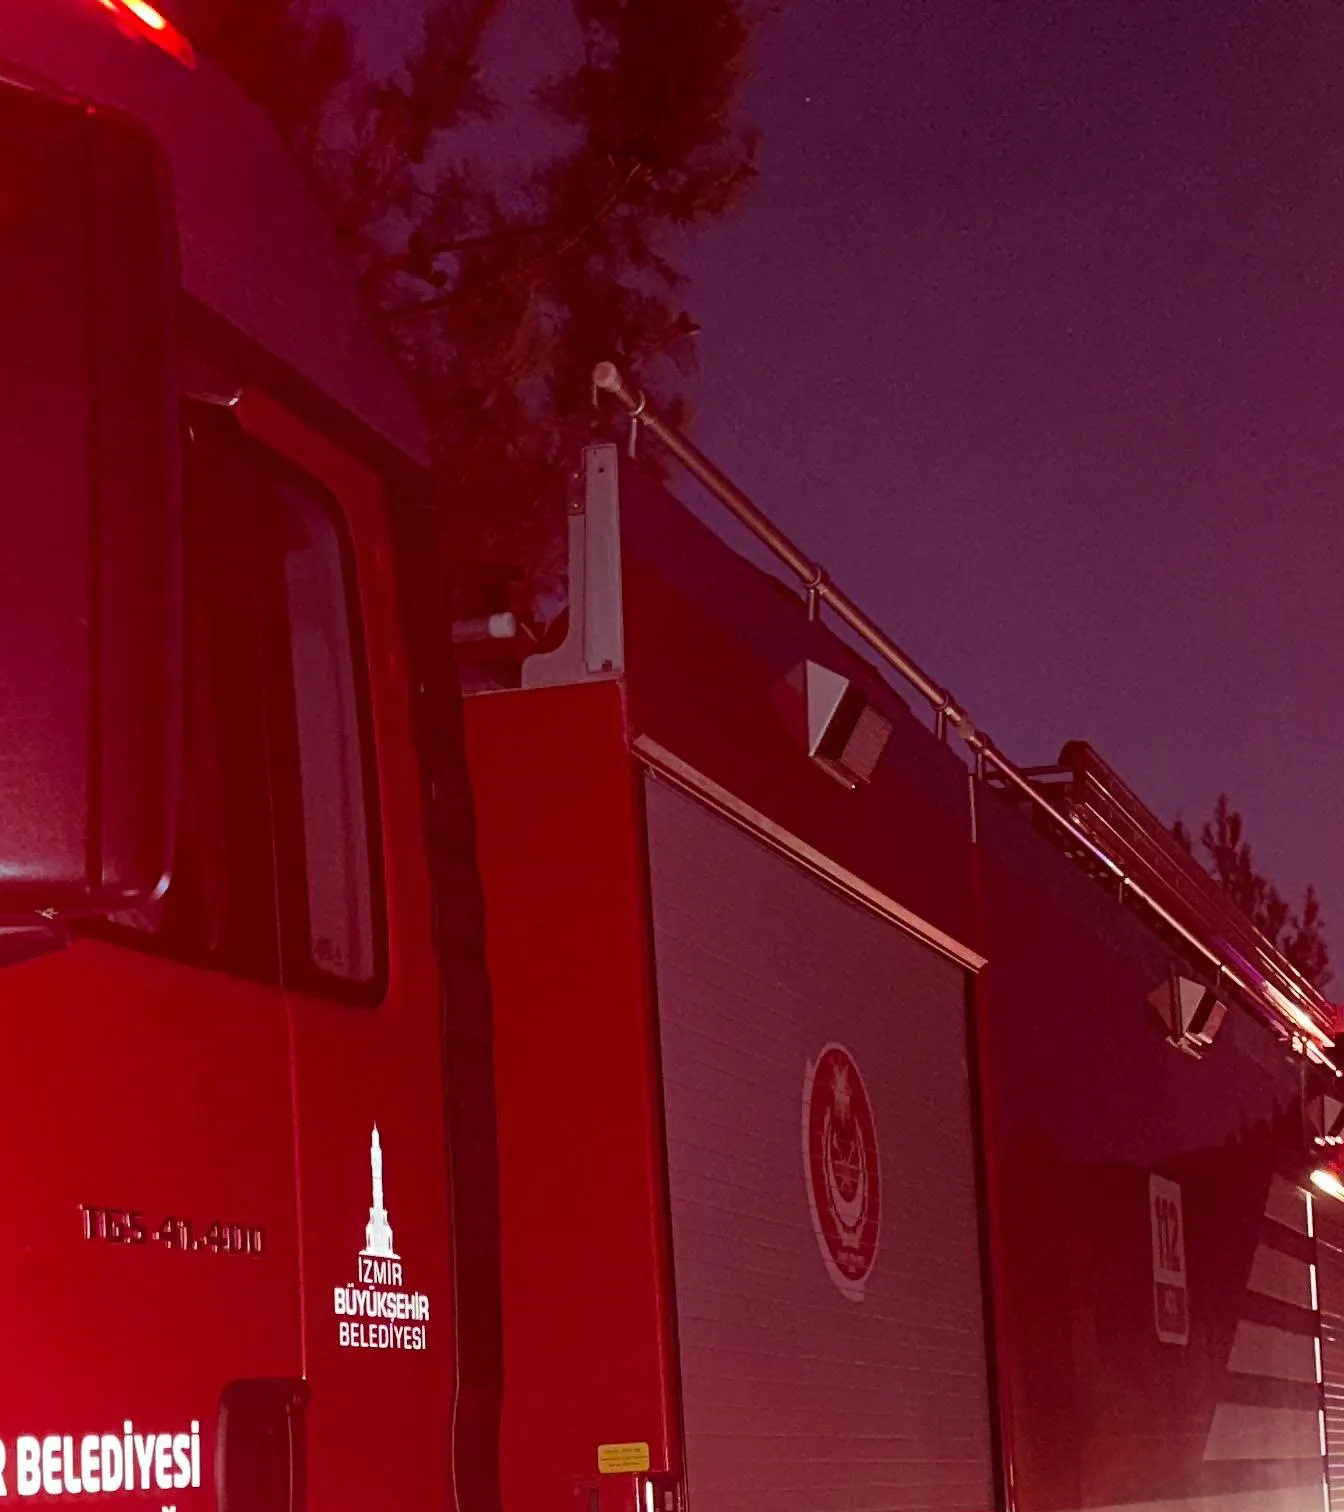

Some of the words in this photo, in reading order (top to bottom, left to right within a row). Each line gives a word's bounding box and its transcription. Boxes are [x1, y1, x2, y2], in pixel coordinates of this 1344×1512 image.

[358, 1256, 403, 1287] İZMİR
[334, 1283, 430, 1323] BÜYÜKŞEHİR
[339, 1321, 427, 1350] BELEDİYESİ
[16, 1419, 201, 1497] BELEDİYESİ
